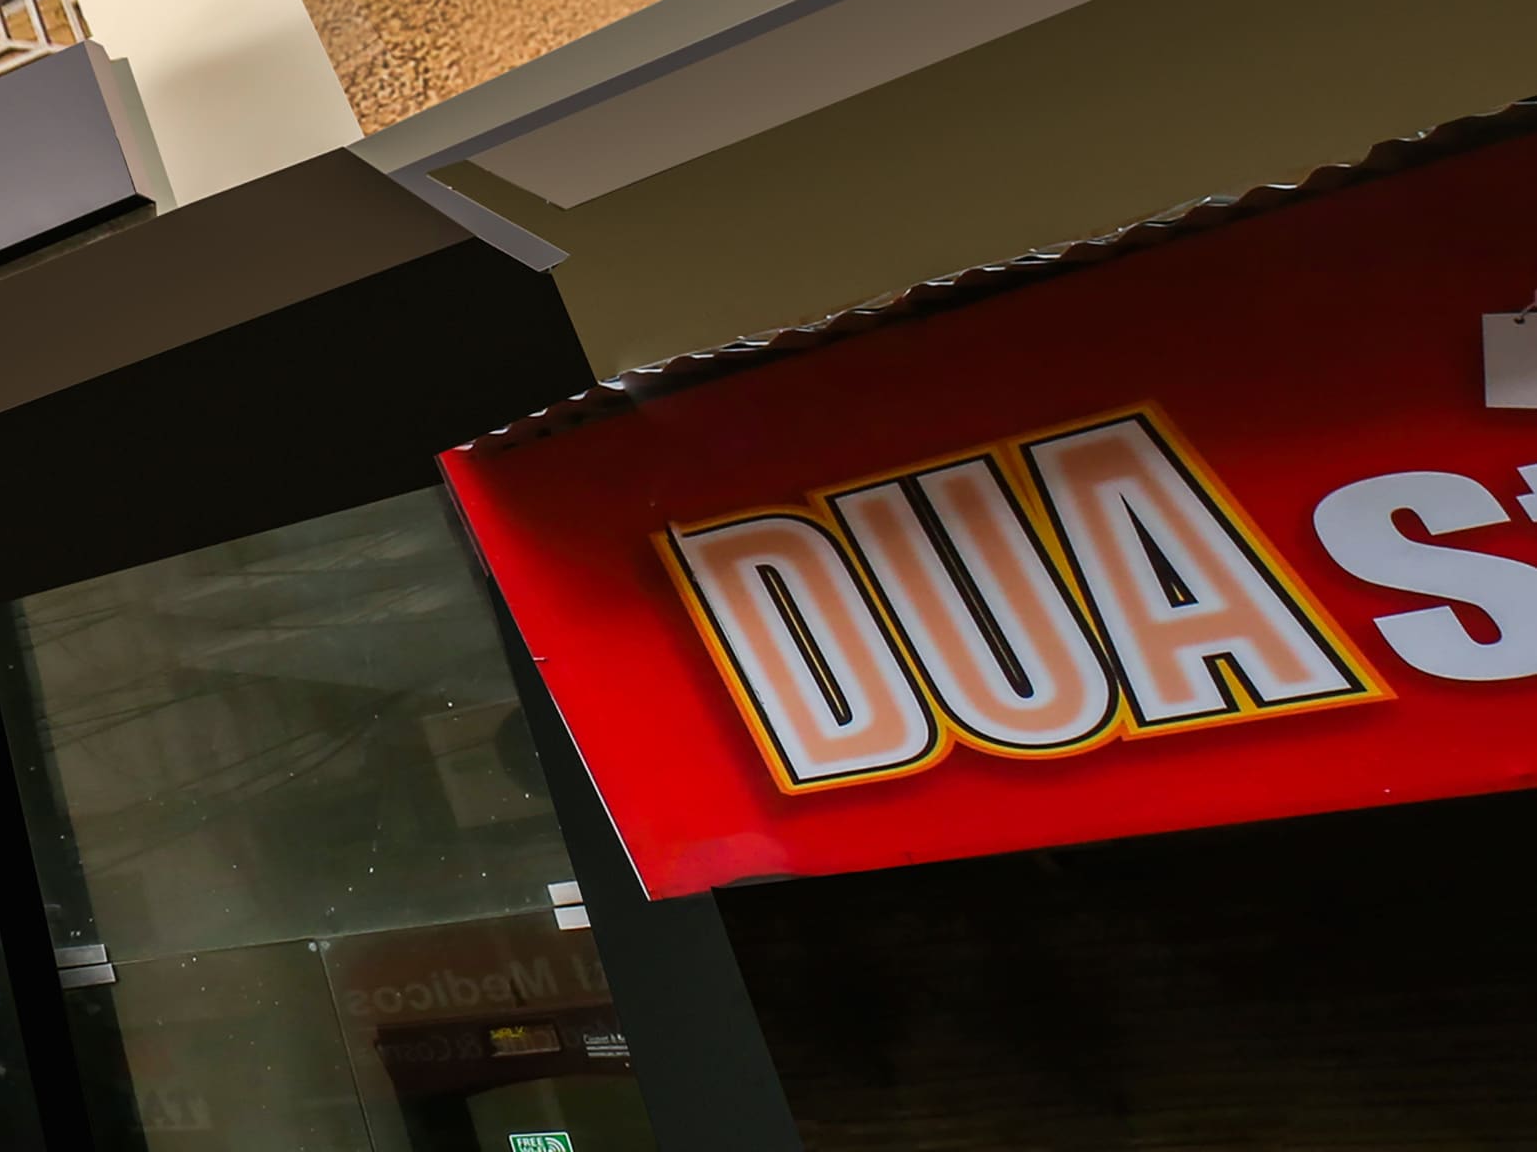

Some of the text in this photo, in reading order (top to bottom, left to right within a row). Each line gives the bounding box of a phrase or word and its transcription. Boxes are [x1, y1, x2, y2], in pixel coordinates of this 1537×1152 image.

[665, 409, 1537, 787] DUA S
[516, 1136, 544, 1148] FREE
